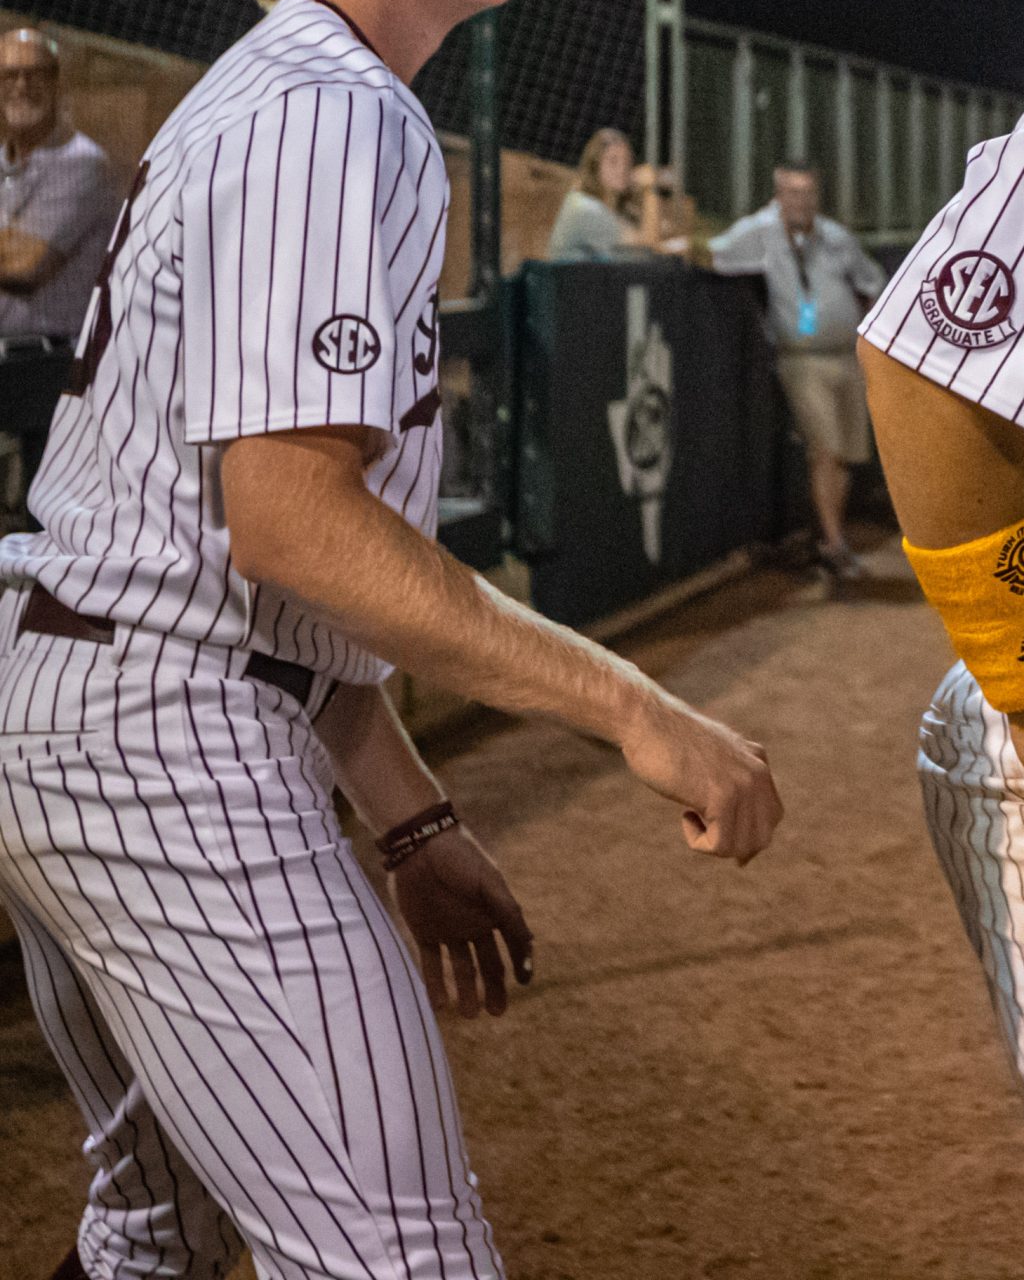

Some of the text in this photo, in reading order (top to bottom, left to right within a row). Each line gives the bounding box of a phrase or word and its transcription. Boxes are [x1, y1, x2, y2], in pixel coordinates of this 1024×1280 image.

[943, 256, 1009, 323] SEC
[317, 318, 377, 372] SEC
[923, 297, 995, 346] GRADUATE
